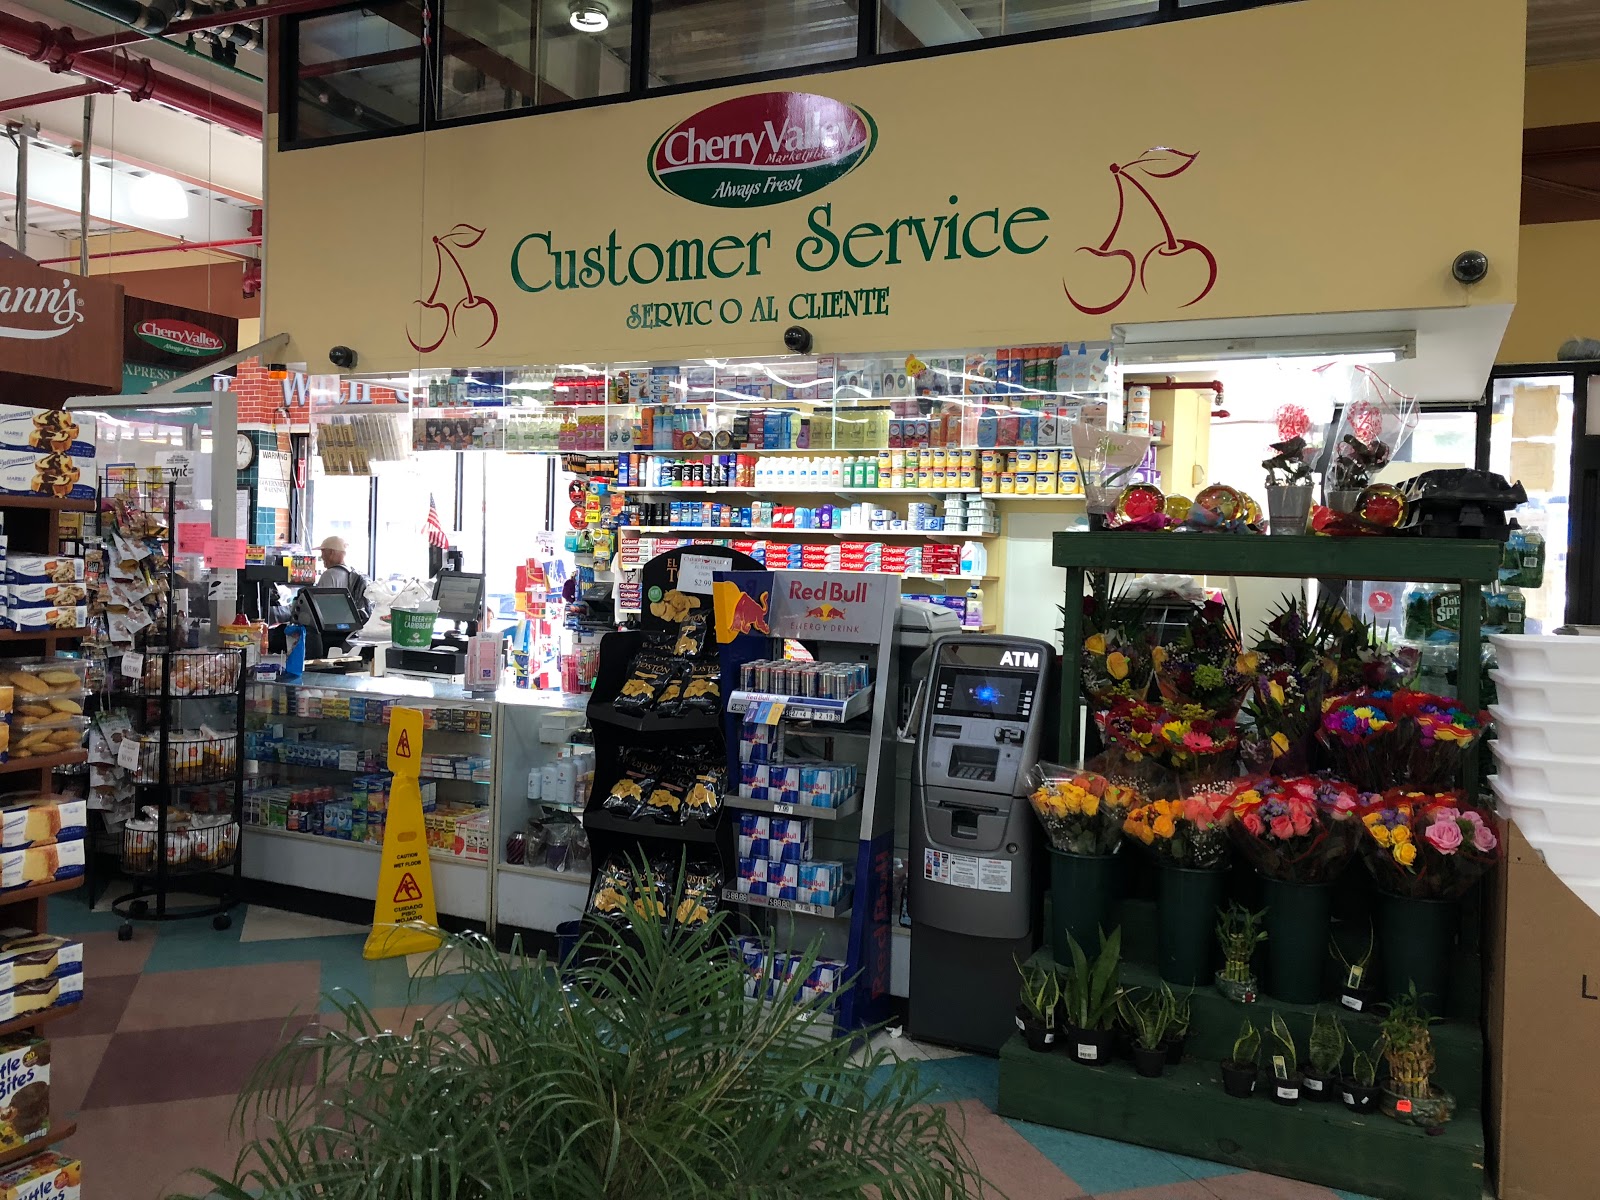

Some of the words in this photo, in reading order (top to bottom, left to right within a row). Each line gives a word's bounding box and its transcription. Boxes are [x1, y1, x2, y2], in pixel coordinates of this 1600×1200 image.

[712, 181, 760, 202] Always
[763, 174, 803, 194] Fresh
[510, 229, 771, 293] Customer
[796, 194, 1049, 272] Service
[750, 295, 779, 323] AL
[788, 286, 890, 321] CLIENTE
[262, 451, 288, 461] WARNING
[170, 466, 188, 477] WIC
[803, 544, 826, 552] Colgate
[841, 543, 864, 551] Colgate
[882, 547, 906, 555] Colgate
[841, 552, 864, 560] Colgate
[882, 555, 905, 563] Colgate
[667, 558, 678, 567] EL
[882, 564, 905, 572] Colgate
[667, 568, 680, 583] T
[694, 579, 712, 587] $2.99
[789, 580, 828, 601] Red
[829, 581, 867, 603] Bull
[411, 615, 425, 623] BEER
[404, 620, 432, 629] CARIBBEAN
[790, 621, 828, 632] ENERGY
[830, 623, 860, 634] DRINK
[999, 650, 1040, 668] ATM
[396, 852, 419, 860] CAUTION
[394, 903, 423, 913] CUIDADO
[395, 914, 423, 924] MOJADO
